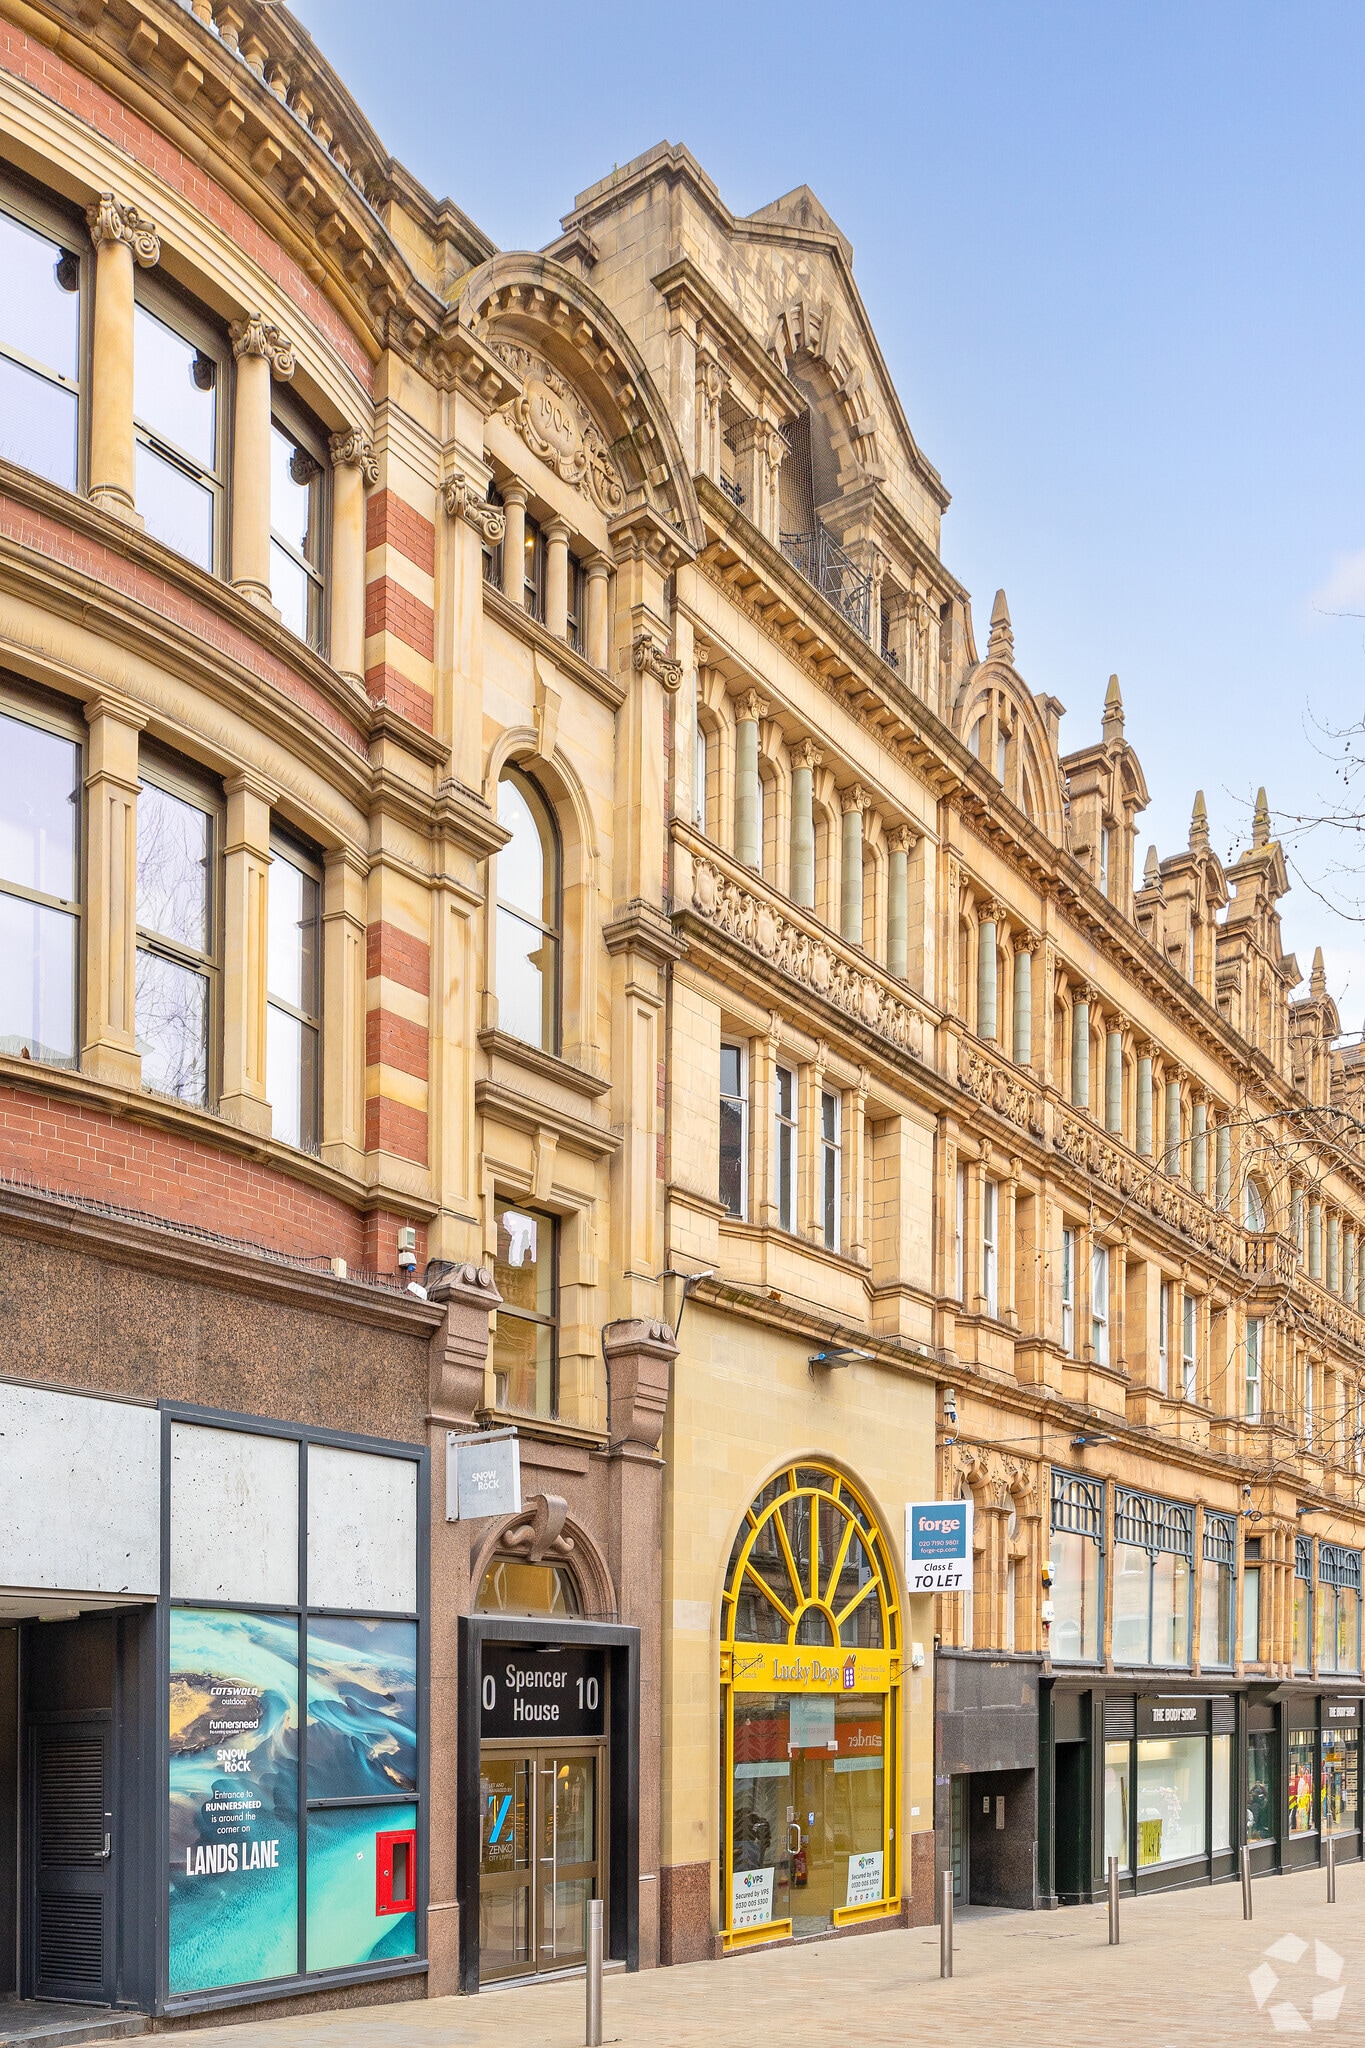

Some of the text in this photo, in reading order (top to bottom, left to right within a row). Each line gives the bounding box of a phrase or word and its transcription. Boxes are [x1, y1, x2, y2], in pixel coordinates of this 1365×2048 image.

[540, 396, 573, 441] 1904
[472, 1470, 496, 1482] SNOW
[478, 1479, 499, 1491] ROCK
[918, 1516, 960, 1534] forge
[924, 1562, 953, 1571] Class E
[915, 1574, 962, 1588] TO LET
[773, 1657, 840, 1685] Lucky Days
[505, 1664, 568, 1692] Spencer
[210, 1687, 258, 1696] COTSWOLD
[576, 1677, 599, 1710] 10
[513, 1698, 560, 1721] House
[1152, 1708, 1165, 1721] THE
[1165, 1708, 1181, 1721] BODY
[209, 1719, 259, 1729] runnersneed
[216, 1749, 247, 1761] SNOW
[224, 1760, 251, 1772] ROCK
[214, 1790, 253, 1799] Entrance to
[205, 1800, 262, 1812] RUNNERSNEED
[211, 1812, 256, 1823] is around the
[217, 1826, 239, 1834] corner
[489, 1844, 513, 1855] ZENKO
[186, 1840, 279, 1876] LANDS LANE
[865, 1857, 874, 1865] VPS
[752, 1875, 763, 1883] VPS
[851, 1872, 866, 1880] Secured
[735, 1891, 753, 1900] Secured
